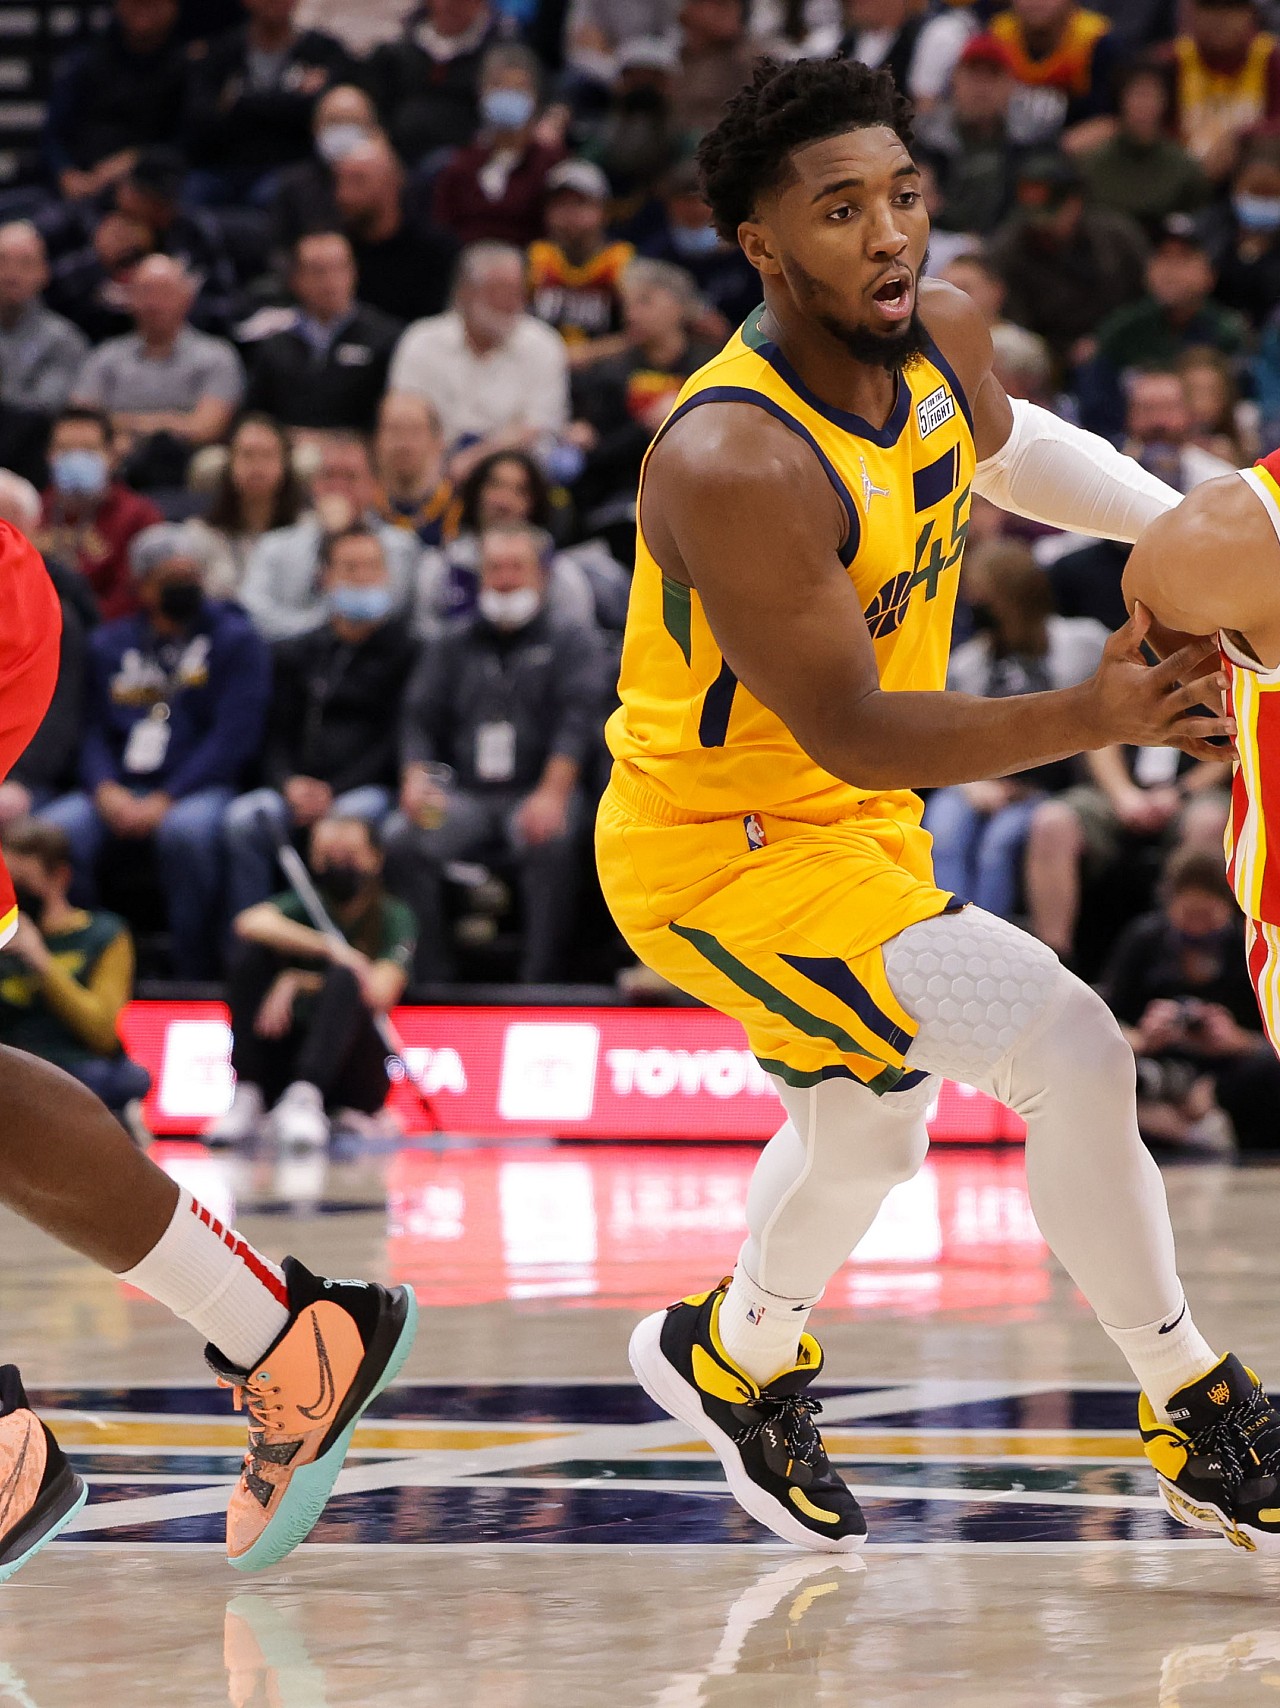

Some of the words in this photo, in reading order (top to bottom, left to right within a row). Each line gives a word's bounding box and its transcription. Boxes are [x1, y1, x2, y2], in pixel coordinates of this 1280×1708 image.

[927, 397, 935, 408] FOR
[934, 391, 944, 403] THE
[918, 406, 928, 434] 5
[930, 402, 951, 427] FIGHT
[909, 482, 972, 602] 45
[605, 1047, 780, 1098] TOYOT
